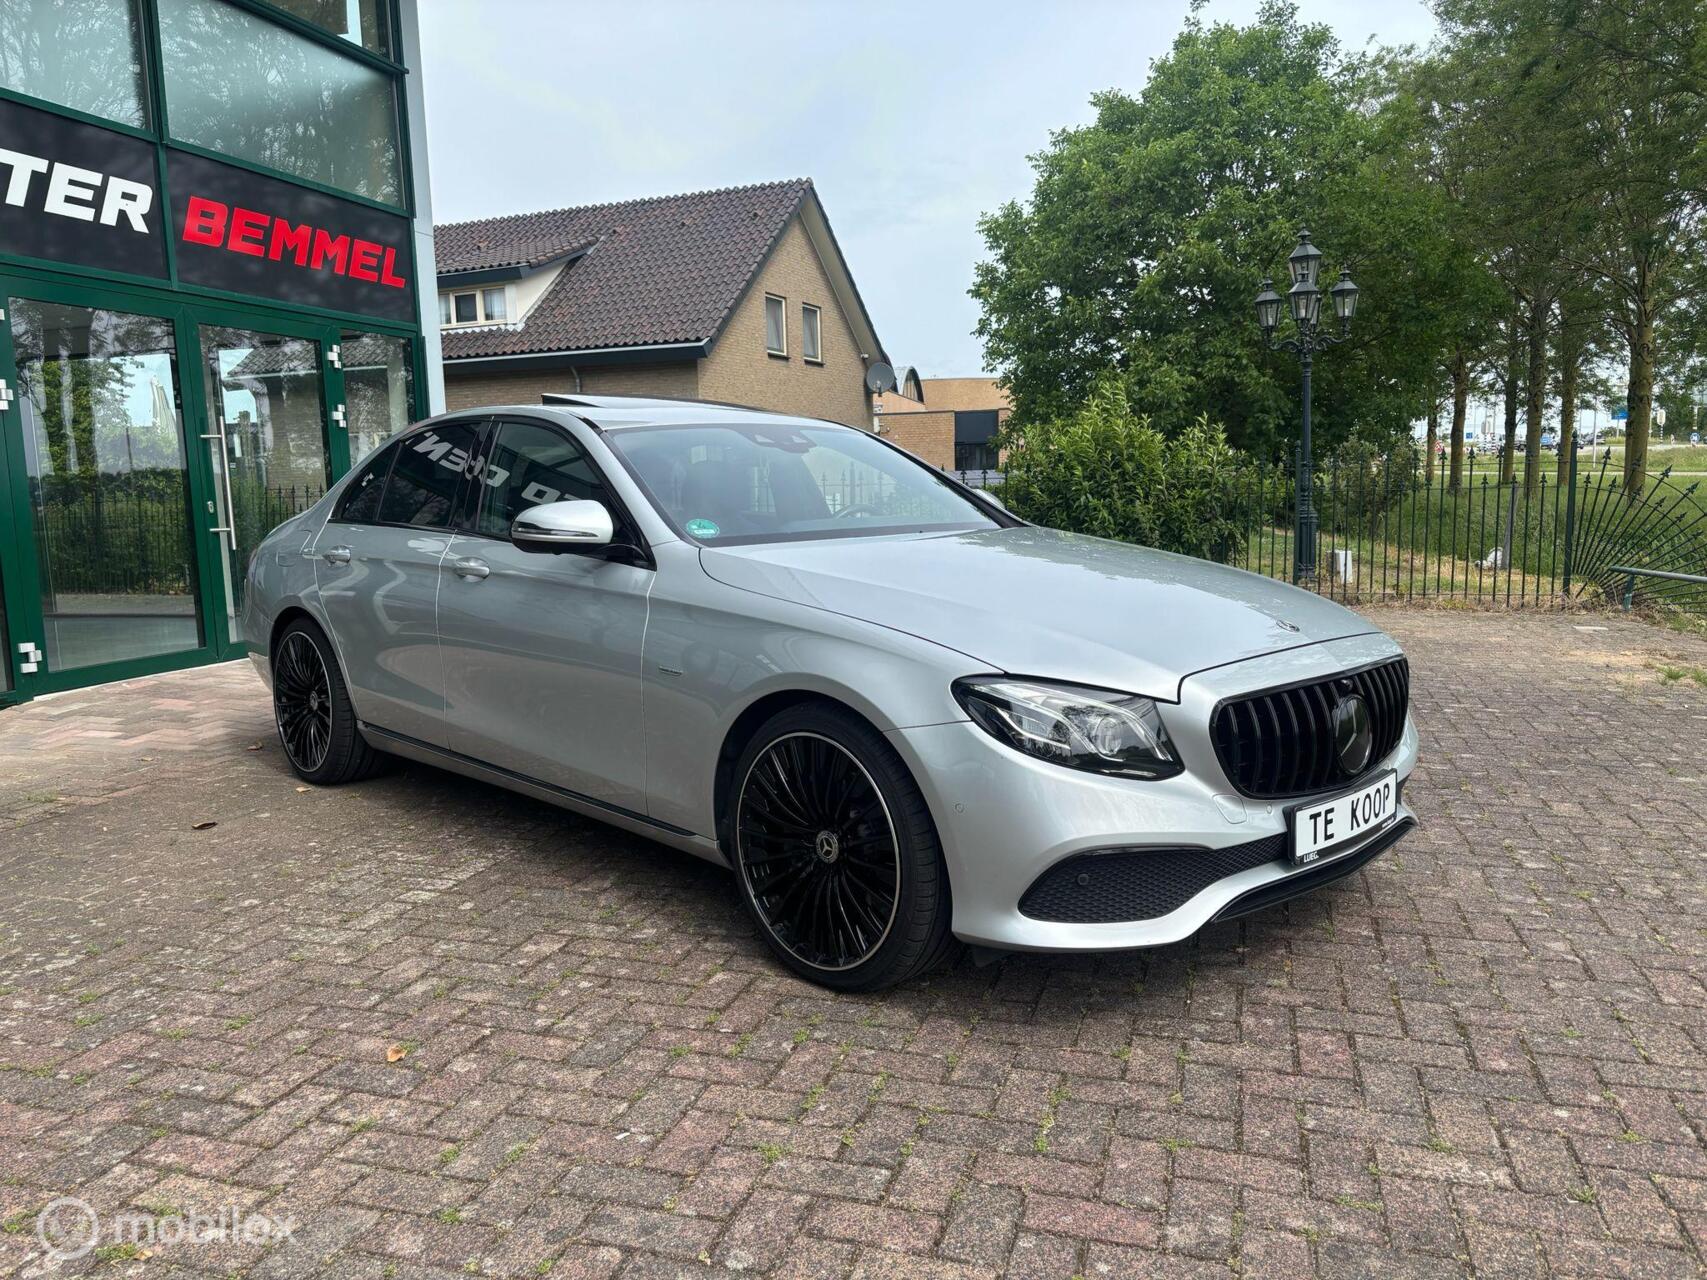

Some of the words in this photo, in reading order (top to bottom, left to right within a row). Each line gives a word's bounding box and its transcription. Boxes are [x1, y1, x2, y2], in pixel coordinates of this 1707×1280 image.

[0, 148, 153, 234] TER
[182, 196, 407, 288] BEMMEL
[1309, 807, 1335, 845] TE
[1350, 783, 1390, 831] KOOP
